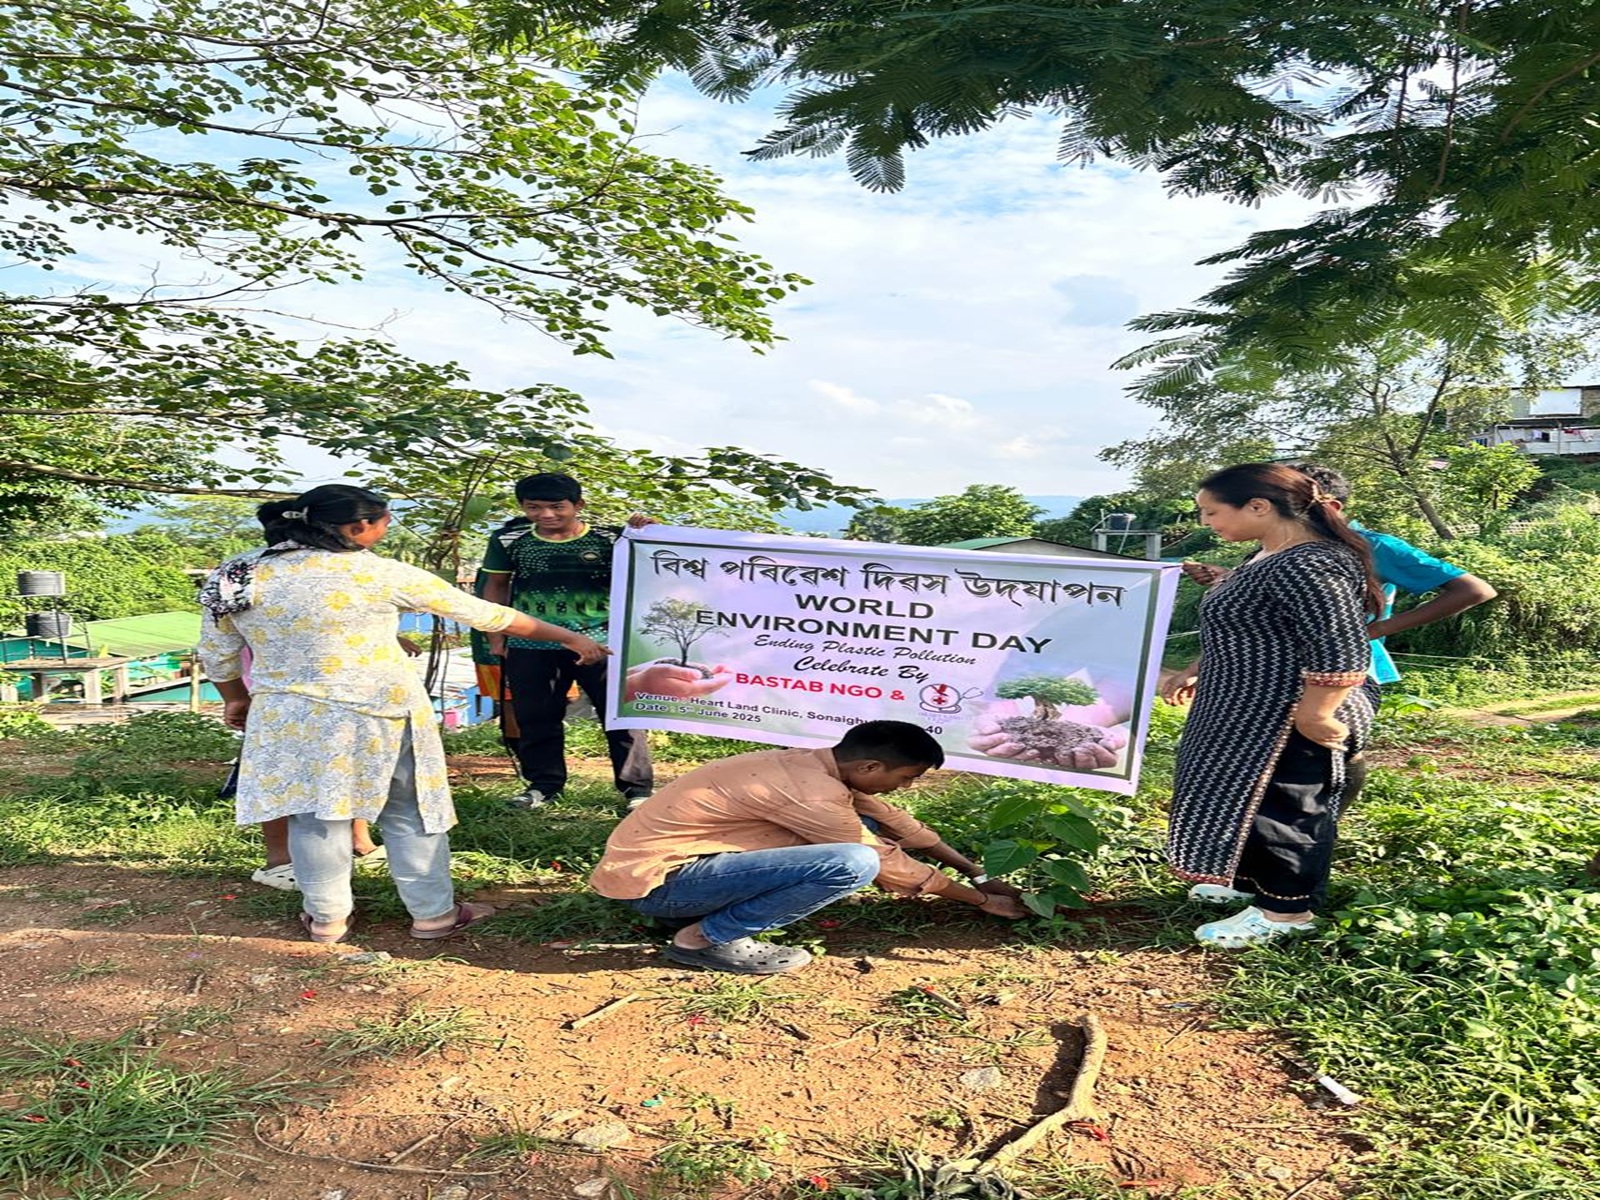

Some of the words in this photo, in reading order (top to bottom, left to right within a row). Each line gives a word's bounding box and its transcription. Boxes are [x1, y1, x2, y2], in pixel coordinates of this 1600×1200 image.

[794, 593, 934, 619] WORLD
[696, 609, 959, 646] ENVIRONMENT
[971, 632, 1053, 654] DAY
[753, 634, 815, 654] Ending
[821, 640, 886, 657] Plastic
[892, 646, 978, 665] Pollution
[793, 655, 889, 677] Celebrate
[898, 665, 931, 684] By
[735, 673, 824, 693] BASTAB
[829, 682, 883, 699] NGO
[889, 690, 906, 701] &
[634, 702, 668, 712] Date
[698, 709, 729, 718] June
[732, 712, 761, 722] 2025
[635, 692, 678, 703] Venue
[690, 697, 725, 708] Heart
[727, 701, 762, 712] Land
